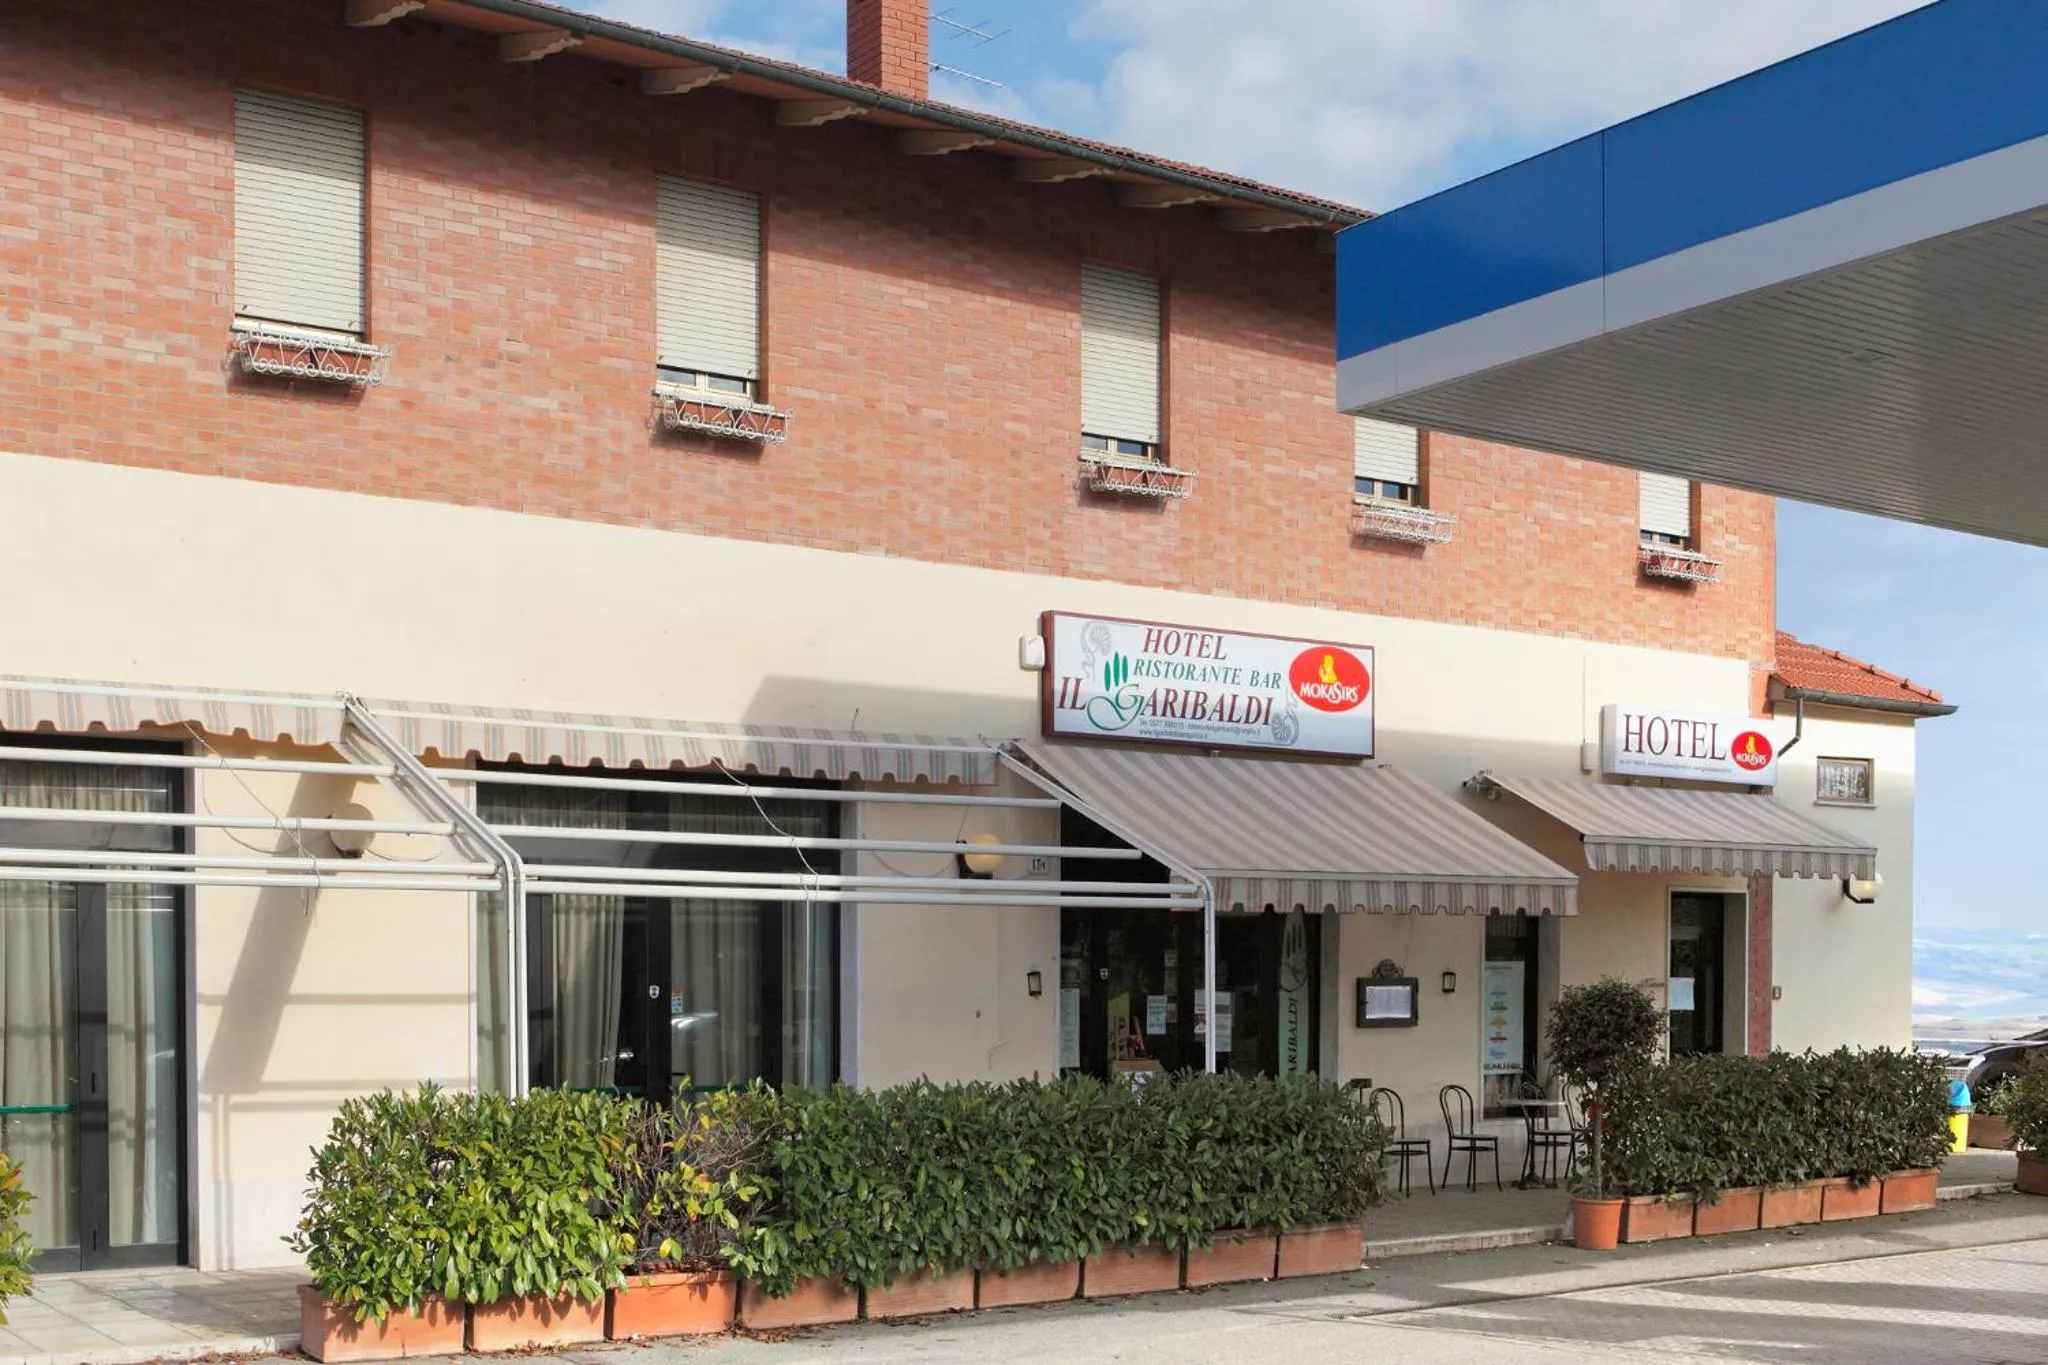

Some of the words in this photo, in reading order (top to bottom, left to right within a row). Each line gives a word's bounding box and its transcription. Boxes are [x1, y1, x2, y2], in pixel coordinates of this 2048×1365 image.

[1143, 627, 1227, 660] HOTEL
[1133, 658, 1242, 686] RISTORANTE
[1249, 669, 1282, 689] BAR
[1056, 676, 1087, 711] IL
[1087, 684, 1274, 731] GARIBALDI
[1622, 713, 1727, 761] HOTEL
